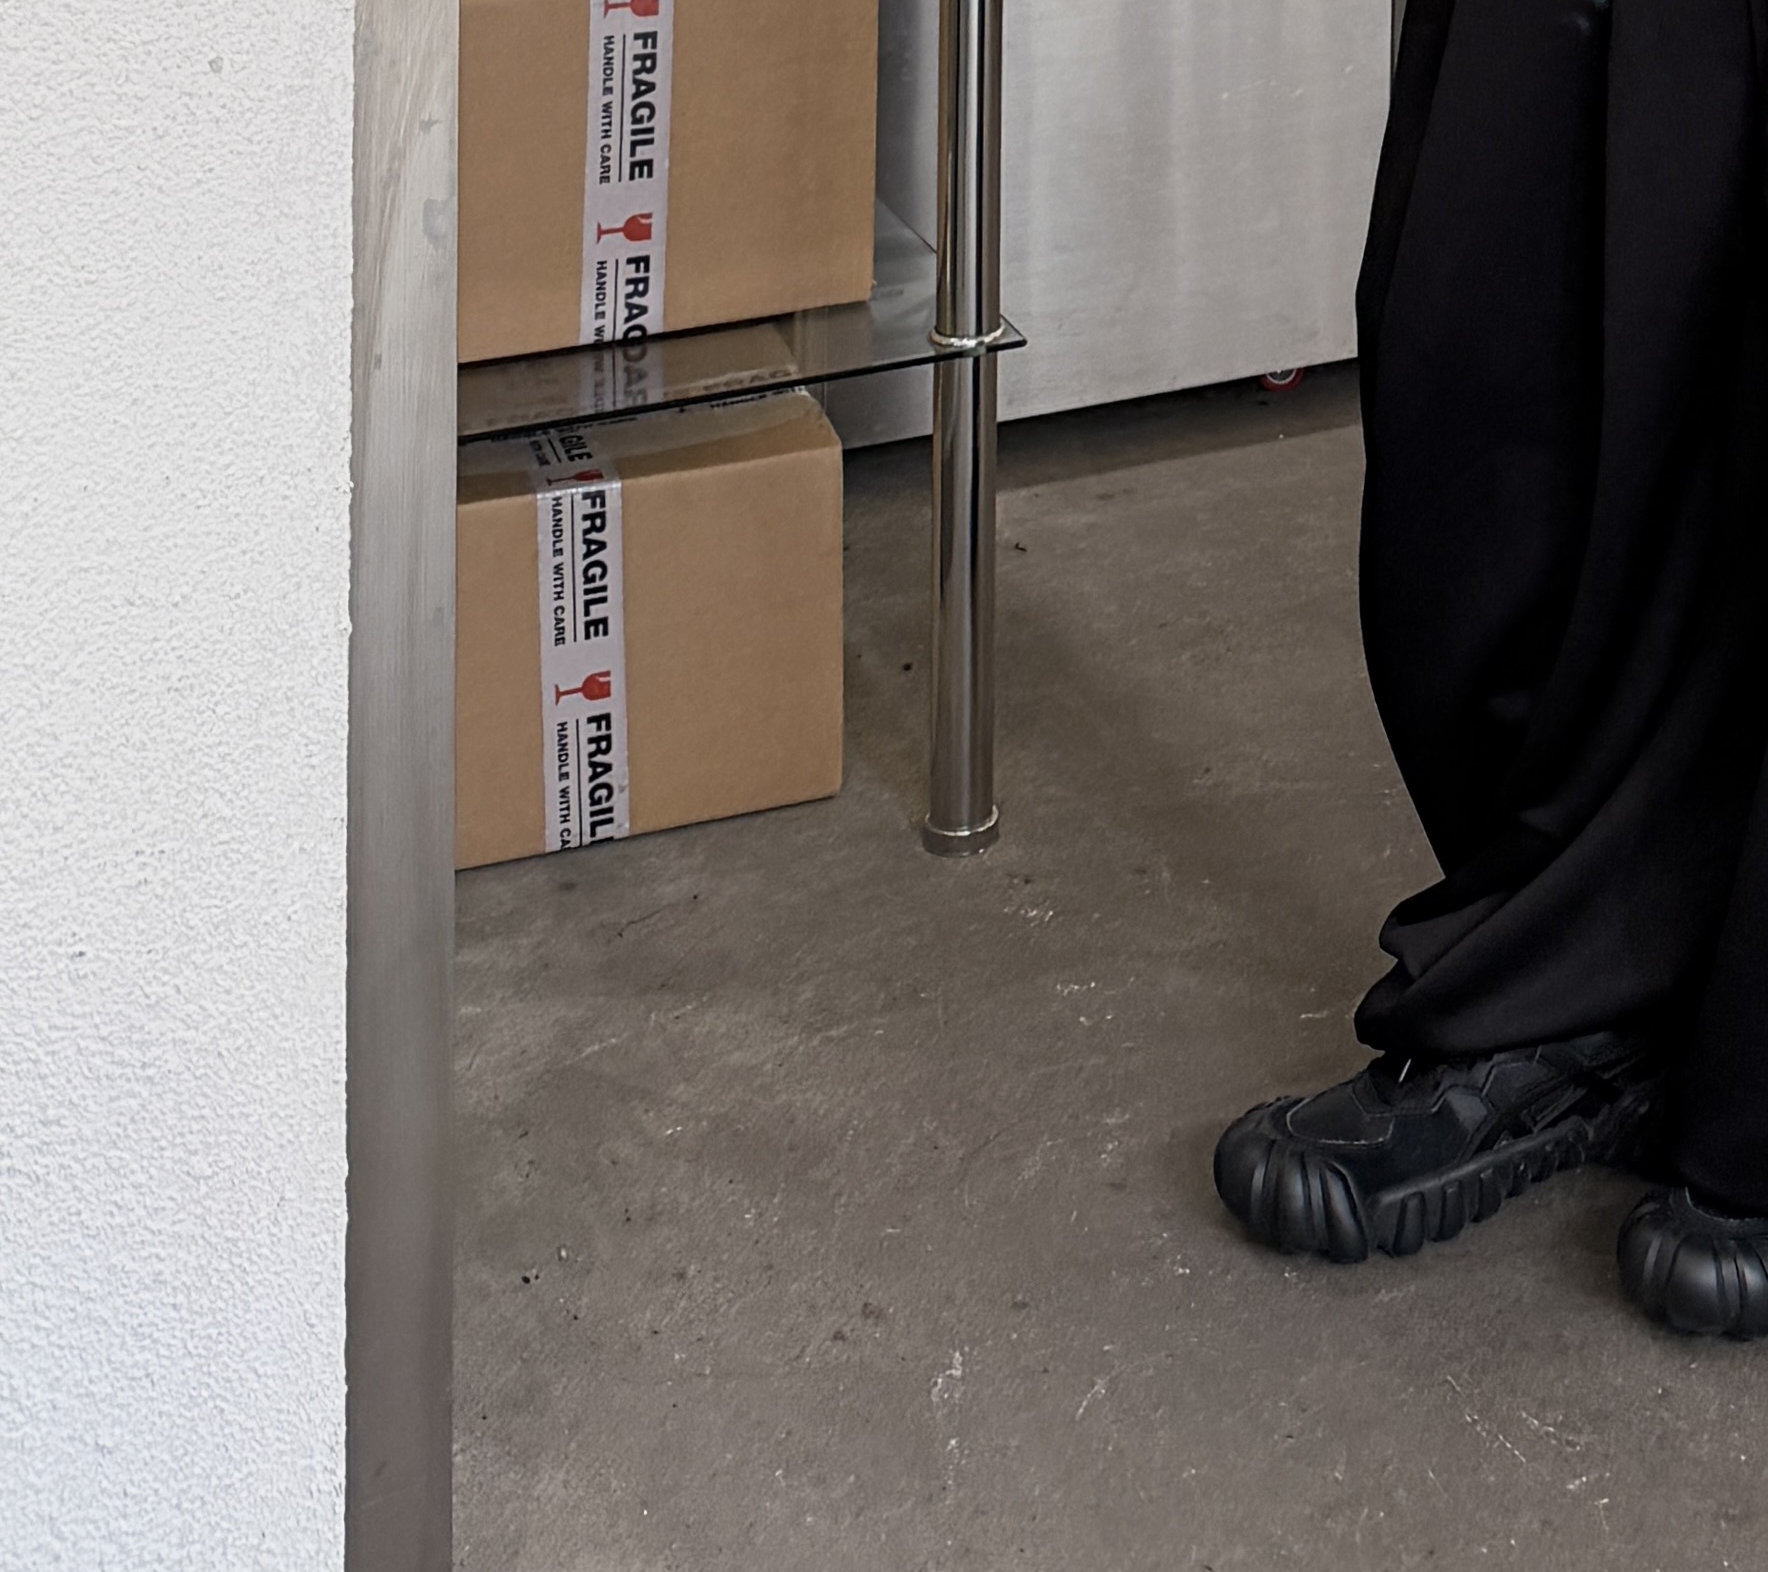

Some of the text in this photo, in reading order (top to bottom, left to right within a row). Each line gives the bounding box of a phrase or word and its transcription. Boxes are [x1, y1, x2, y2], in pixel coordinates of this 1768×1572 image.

[599, 35, 615, 185] HANDLE WITH CARE
[629, 31, 658, 181] FRAGILE
[595, 260, 608, 321] HANDLE
[558, 434, 594, 463] GILE
[552, 497, 566, 647] HANDLE WITH CARE
[582, 490, 609, 641] FRAGILE
[557, 722, 570, 782] HANDLE
[559, 786, 571, 824] WITH
